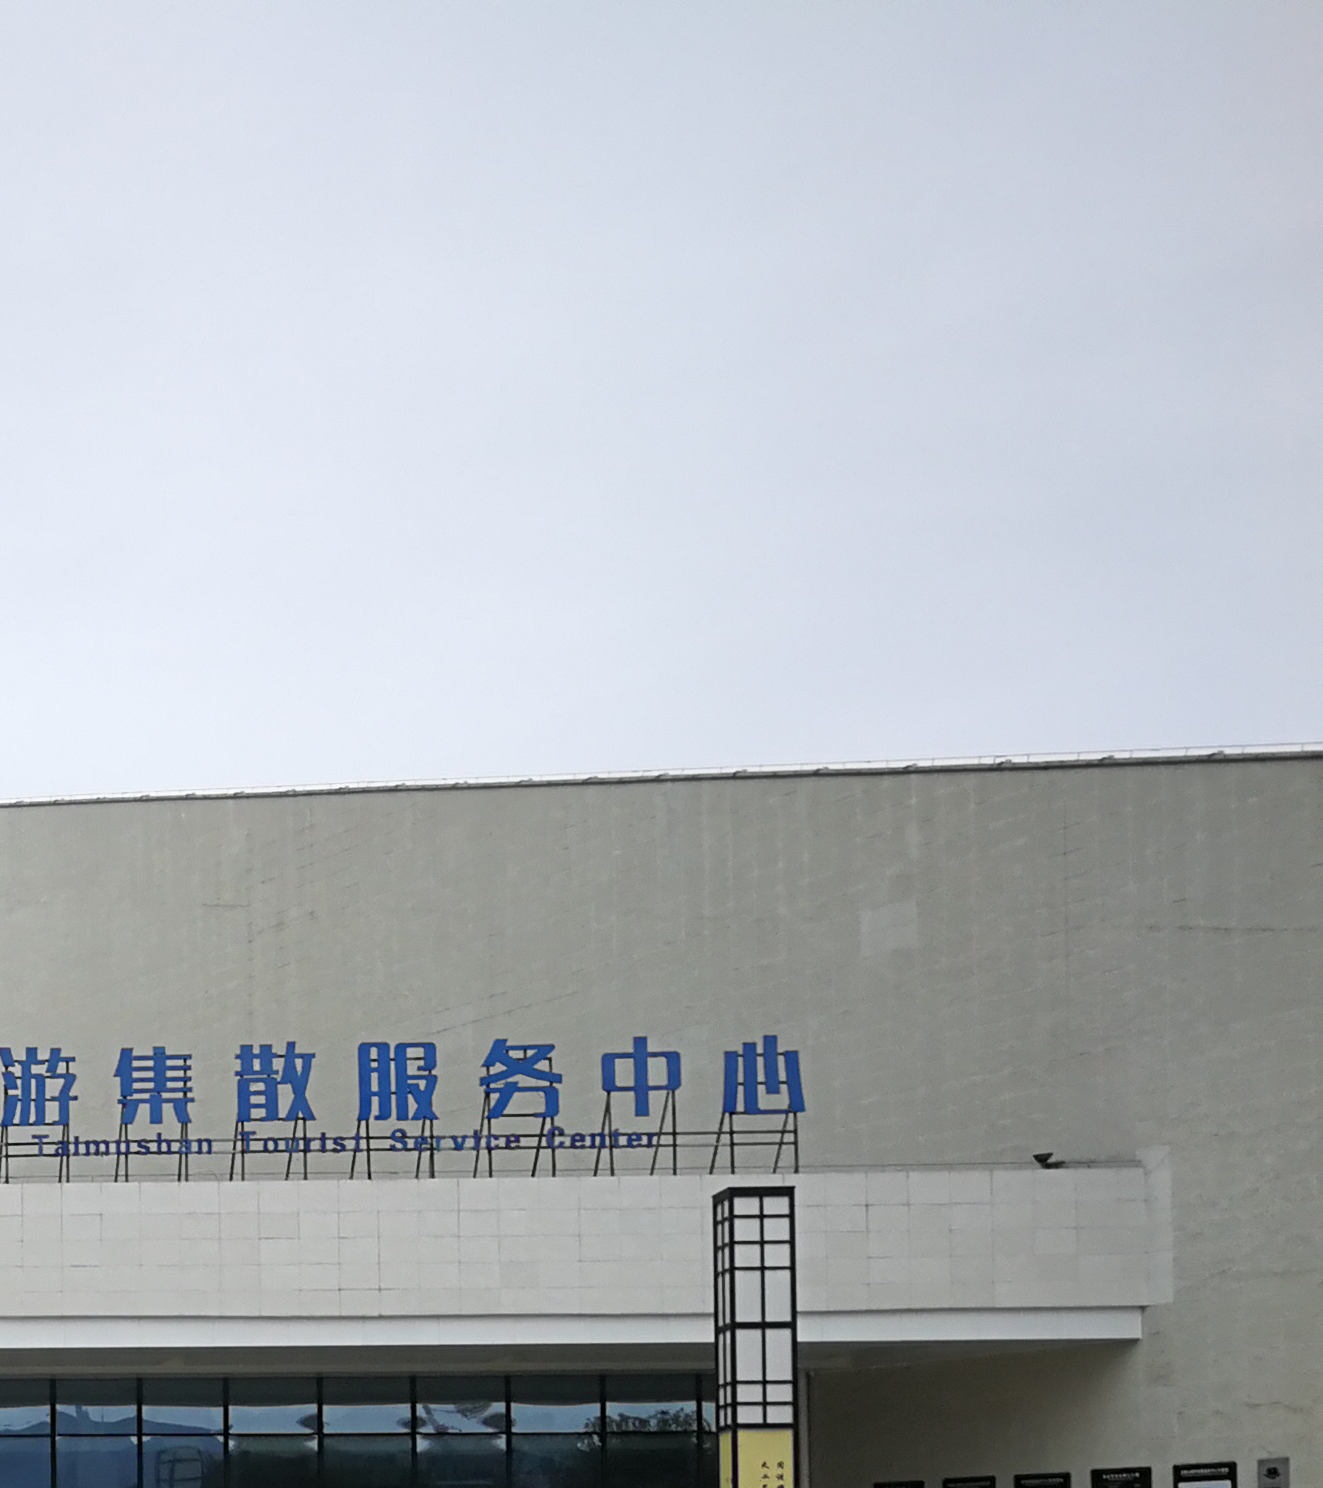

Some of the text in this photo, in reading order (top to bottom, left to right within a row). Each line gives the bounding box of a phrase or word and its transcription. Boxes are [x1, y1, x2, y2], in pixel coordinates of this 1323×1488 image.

[240, 1129, 362, 1154] Tourist
[389, 1128, 521, 1152] Service
[546, 1126, 659, 1150] Center
